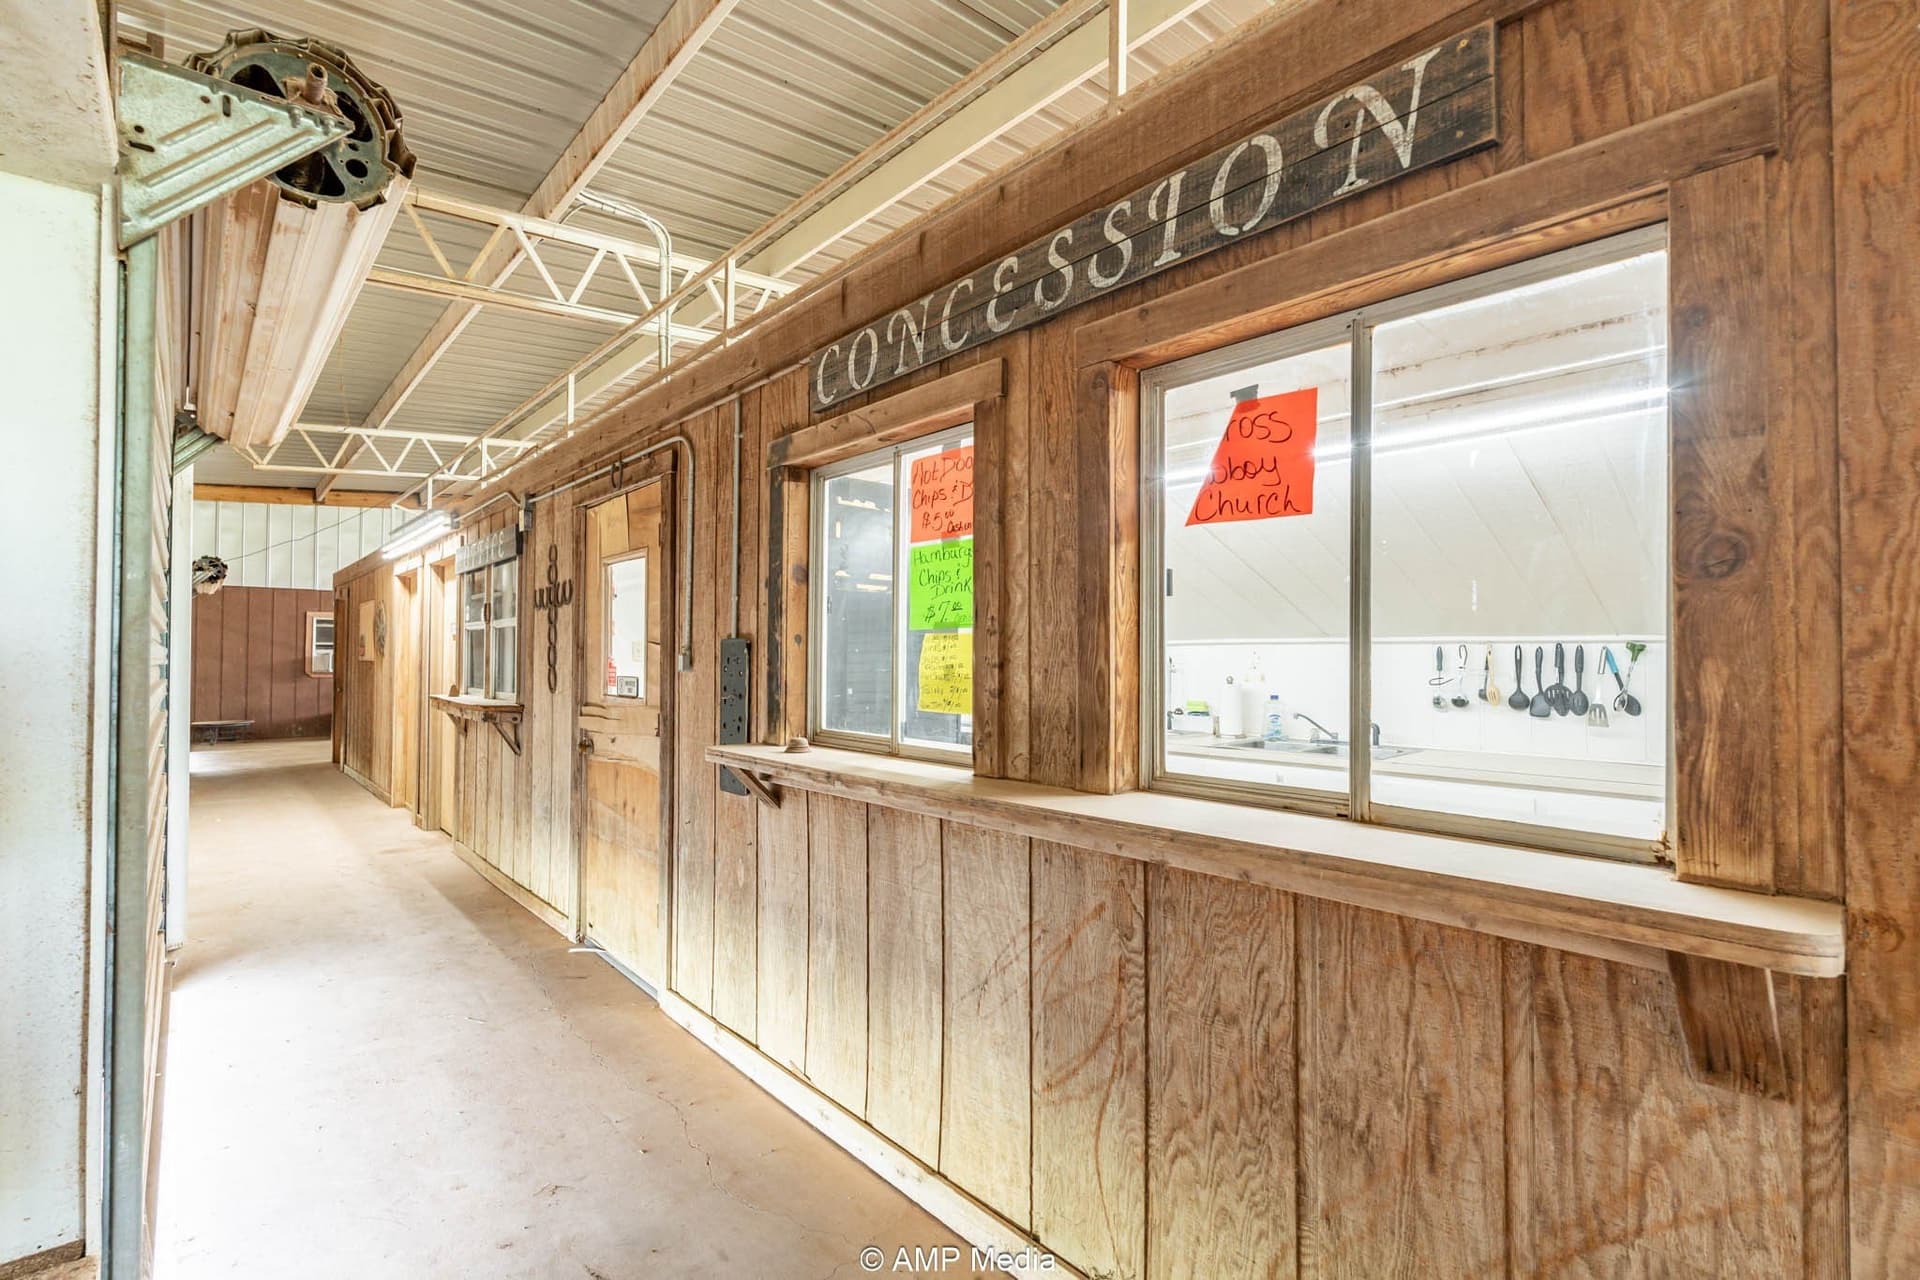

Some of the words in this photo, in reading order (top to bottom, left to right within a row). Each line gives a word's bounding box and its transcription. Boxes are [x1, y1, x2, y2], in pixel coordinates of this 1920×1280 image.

[817, 48, 1440, 405] CONCESSION
[912, 461, 938, 486] Hot
[912, 489, 947, 509] Chips
[1194, 485, 1301, 521] Church
[919, 568, 952, 587] Chips
[929, 576, 972, 600] Drink
